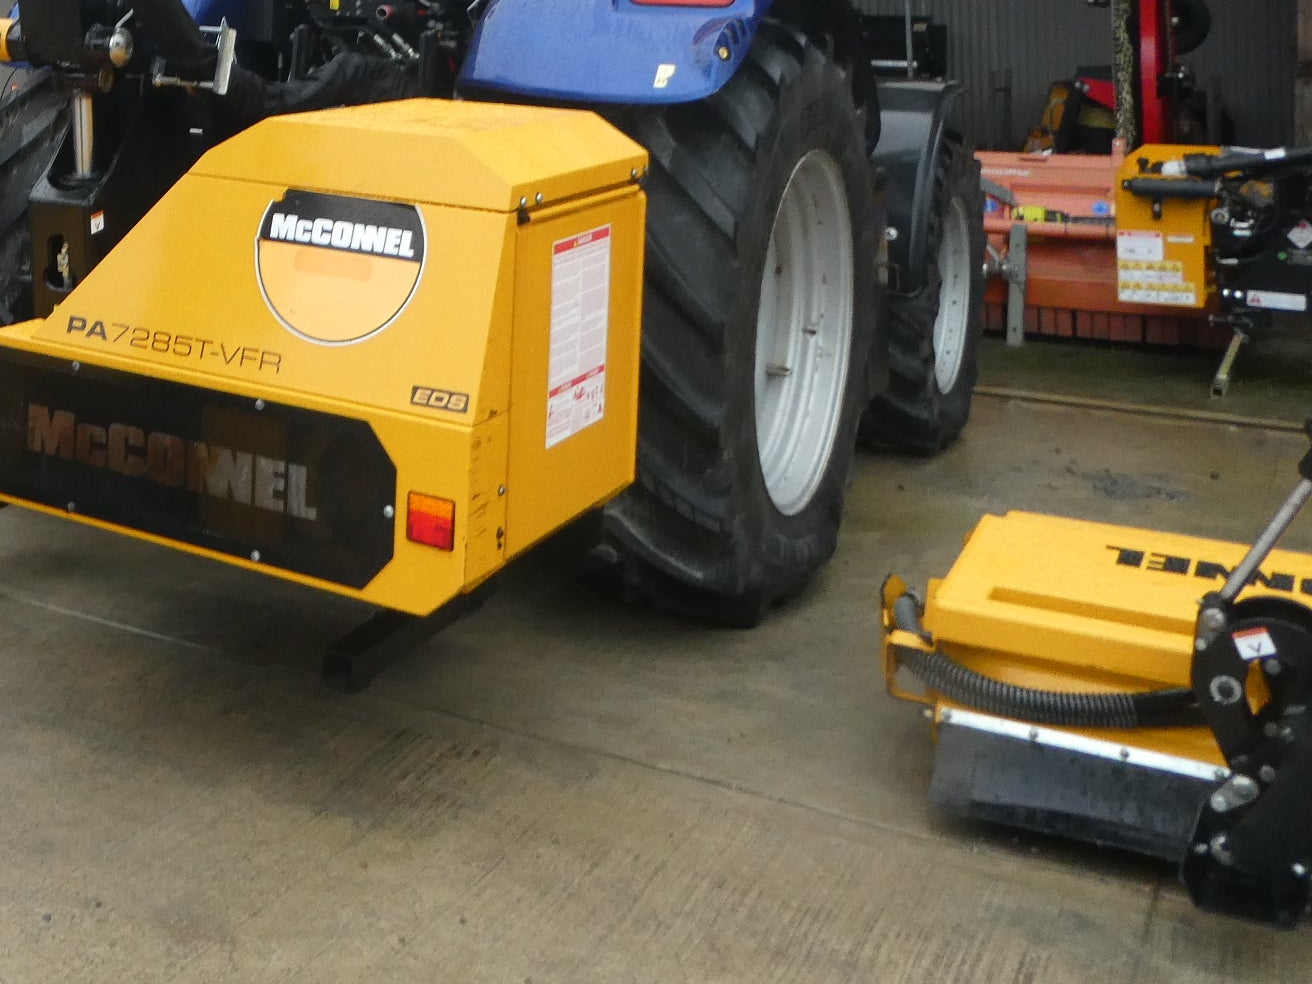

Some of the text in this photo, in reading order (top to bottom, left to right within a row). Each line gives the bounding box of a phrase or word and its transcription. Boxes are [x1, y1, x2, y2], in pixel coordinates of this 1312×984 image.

[269, 212, 414, 258] McCONNEL
[66, 315, 282, 375] PA7285T-VFR
[412, 387, 467, 411] EDS
[27, 403, 318, 521] McCONNEL
